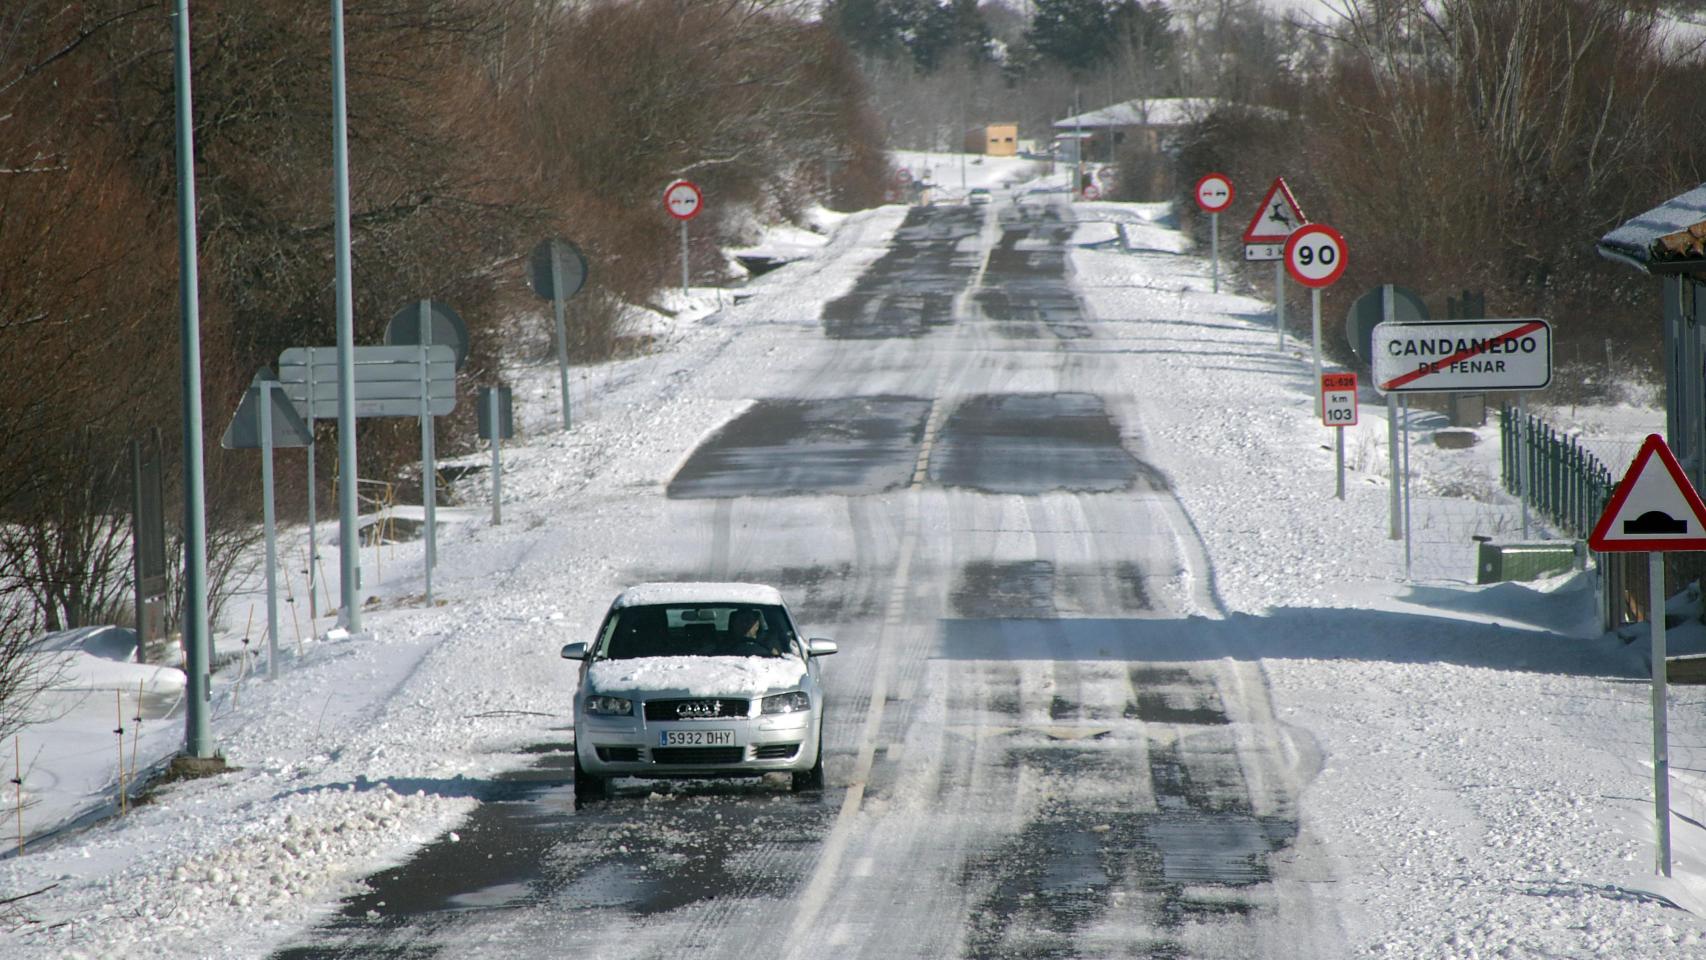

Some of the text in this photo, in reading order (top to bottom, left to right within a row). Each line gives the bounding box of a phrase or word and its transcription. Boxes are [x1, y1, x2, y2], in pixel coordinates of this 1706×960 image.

[1299, 245, 1335, 266] 90
[1388, 337, 1537, 356] CANDANEDO
[1418, 360, 1507, 374] DE FENAR
[1332, 394, 1348, 403] km
[1327, 408, 1352, 421] 103
[668, 732, 731, 745] 5932 DHY
